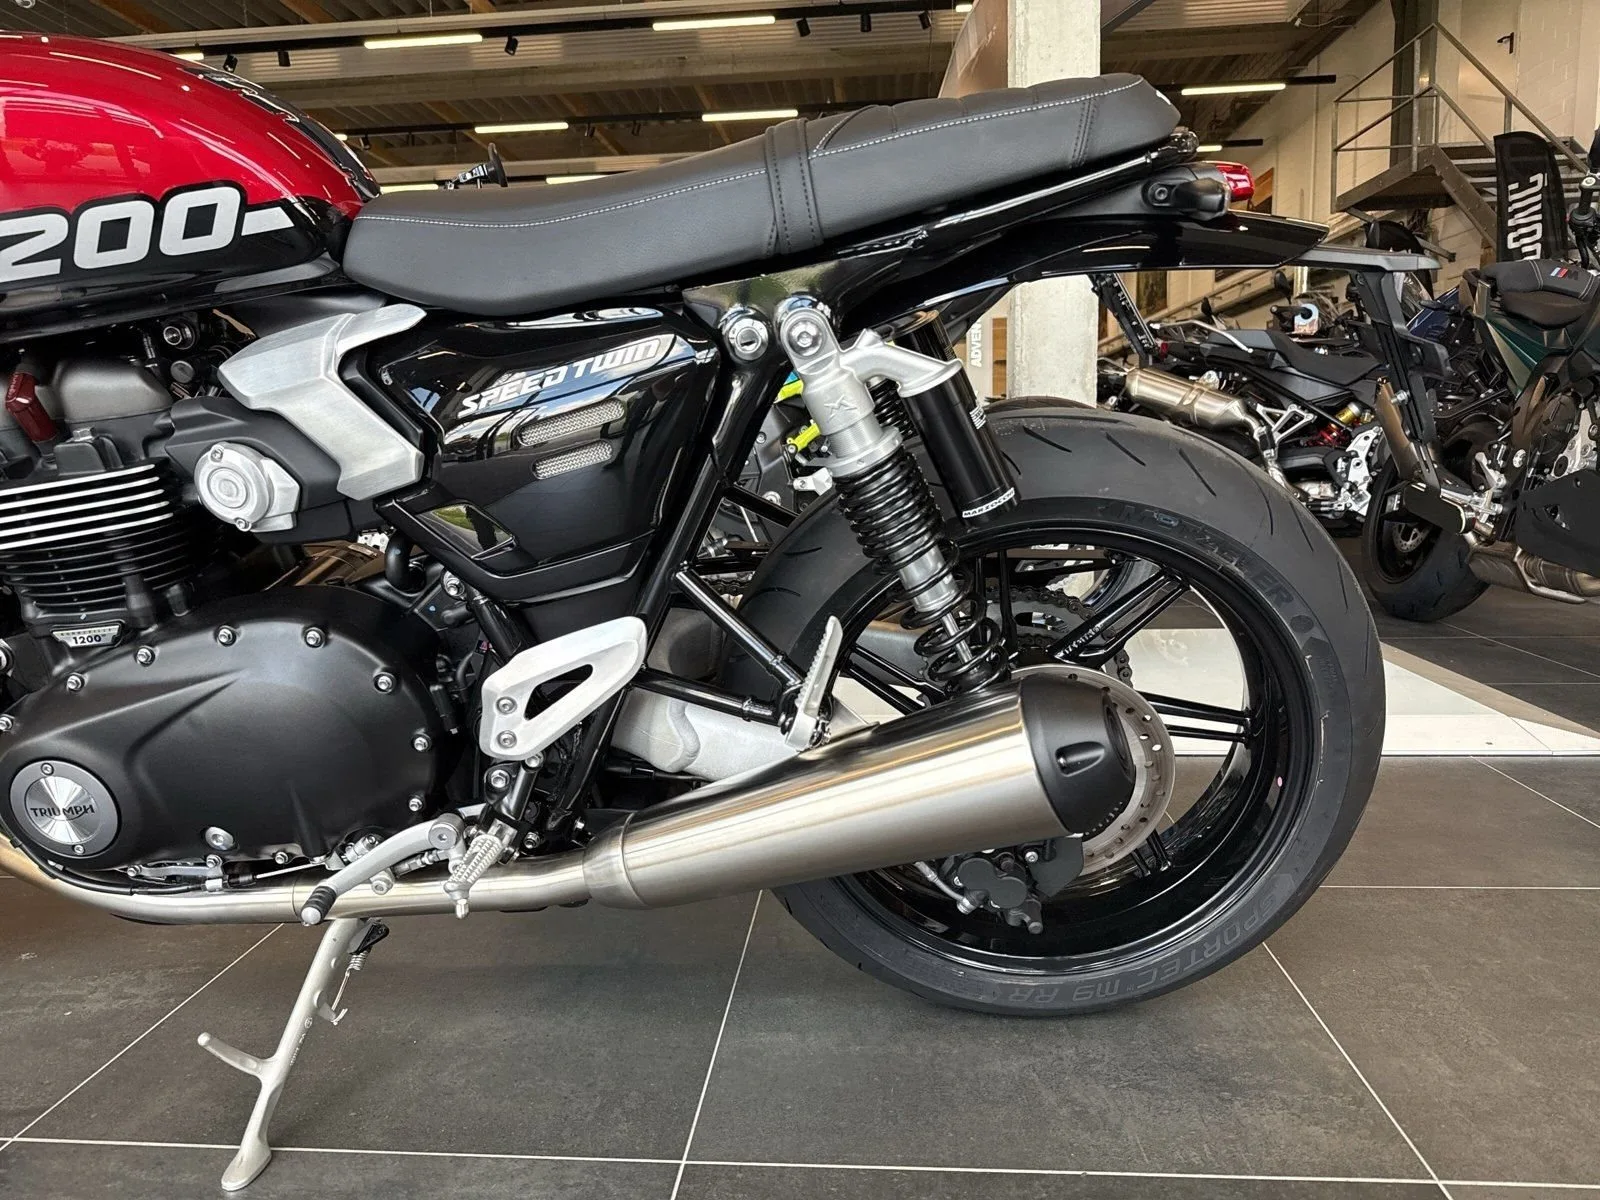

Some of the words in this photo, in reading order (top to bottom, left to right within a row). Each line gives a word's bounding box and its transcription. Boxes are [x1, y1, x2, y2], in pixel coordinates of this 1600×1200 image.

[457, 367, 568, 419] SPEED
[72, 634, 102, 645] 1200
[30, 804, 95, 818] TRIUMPH
